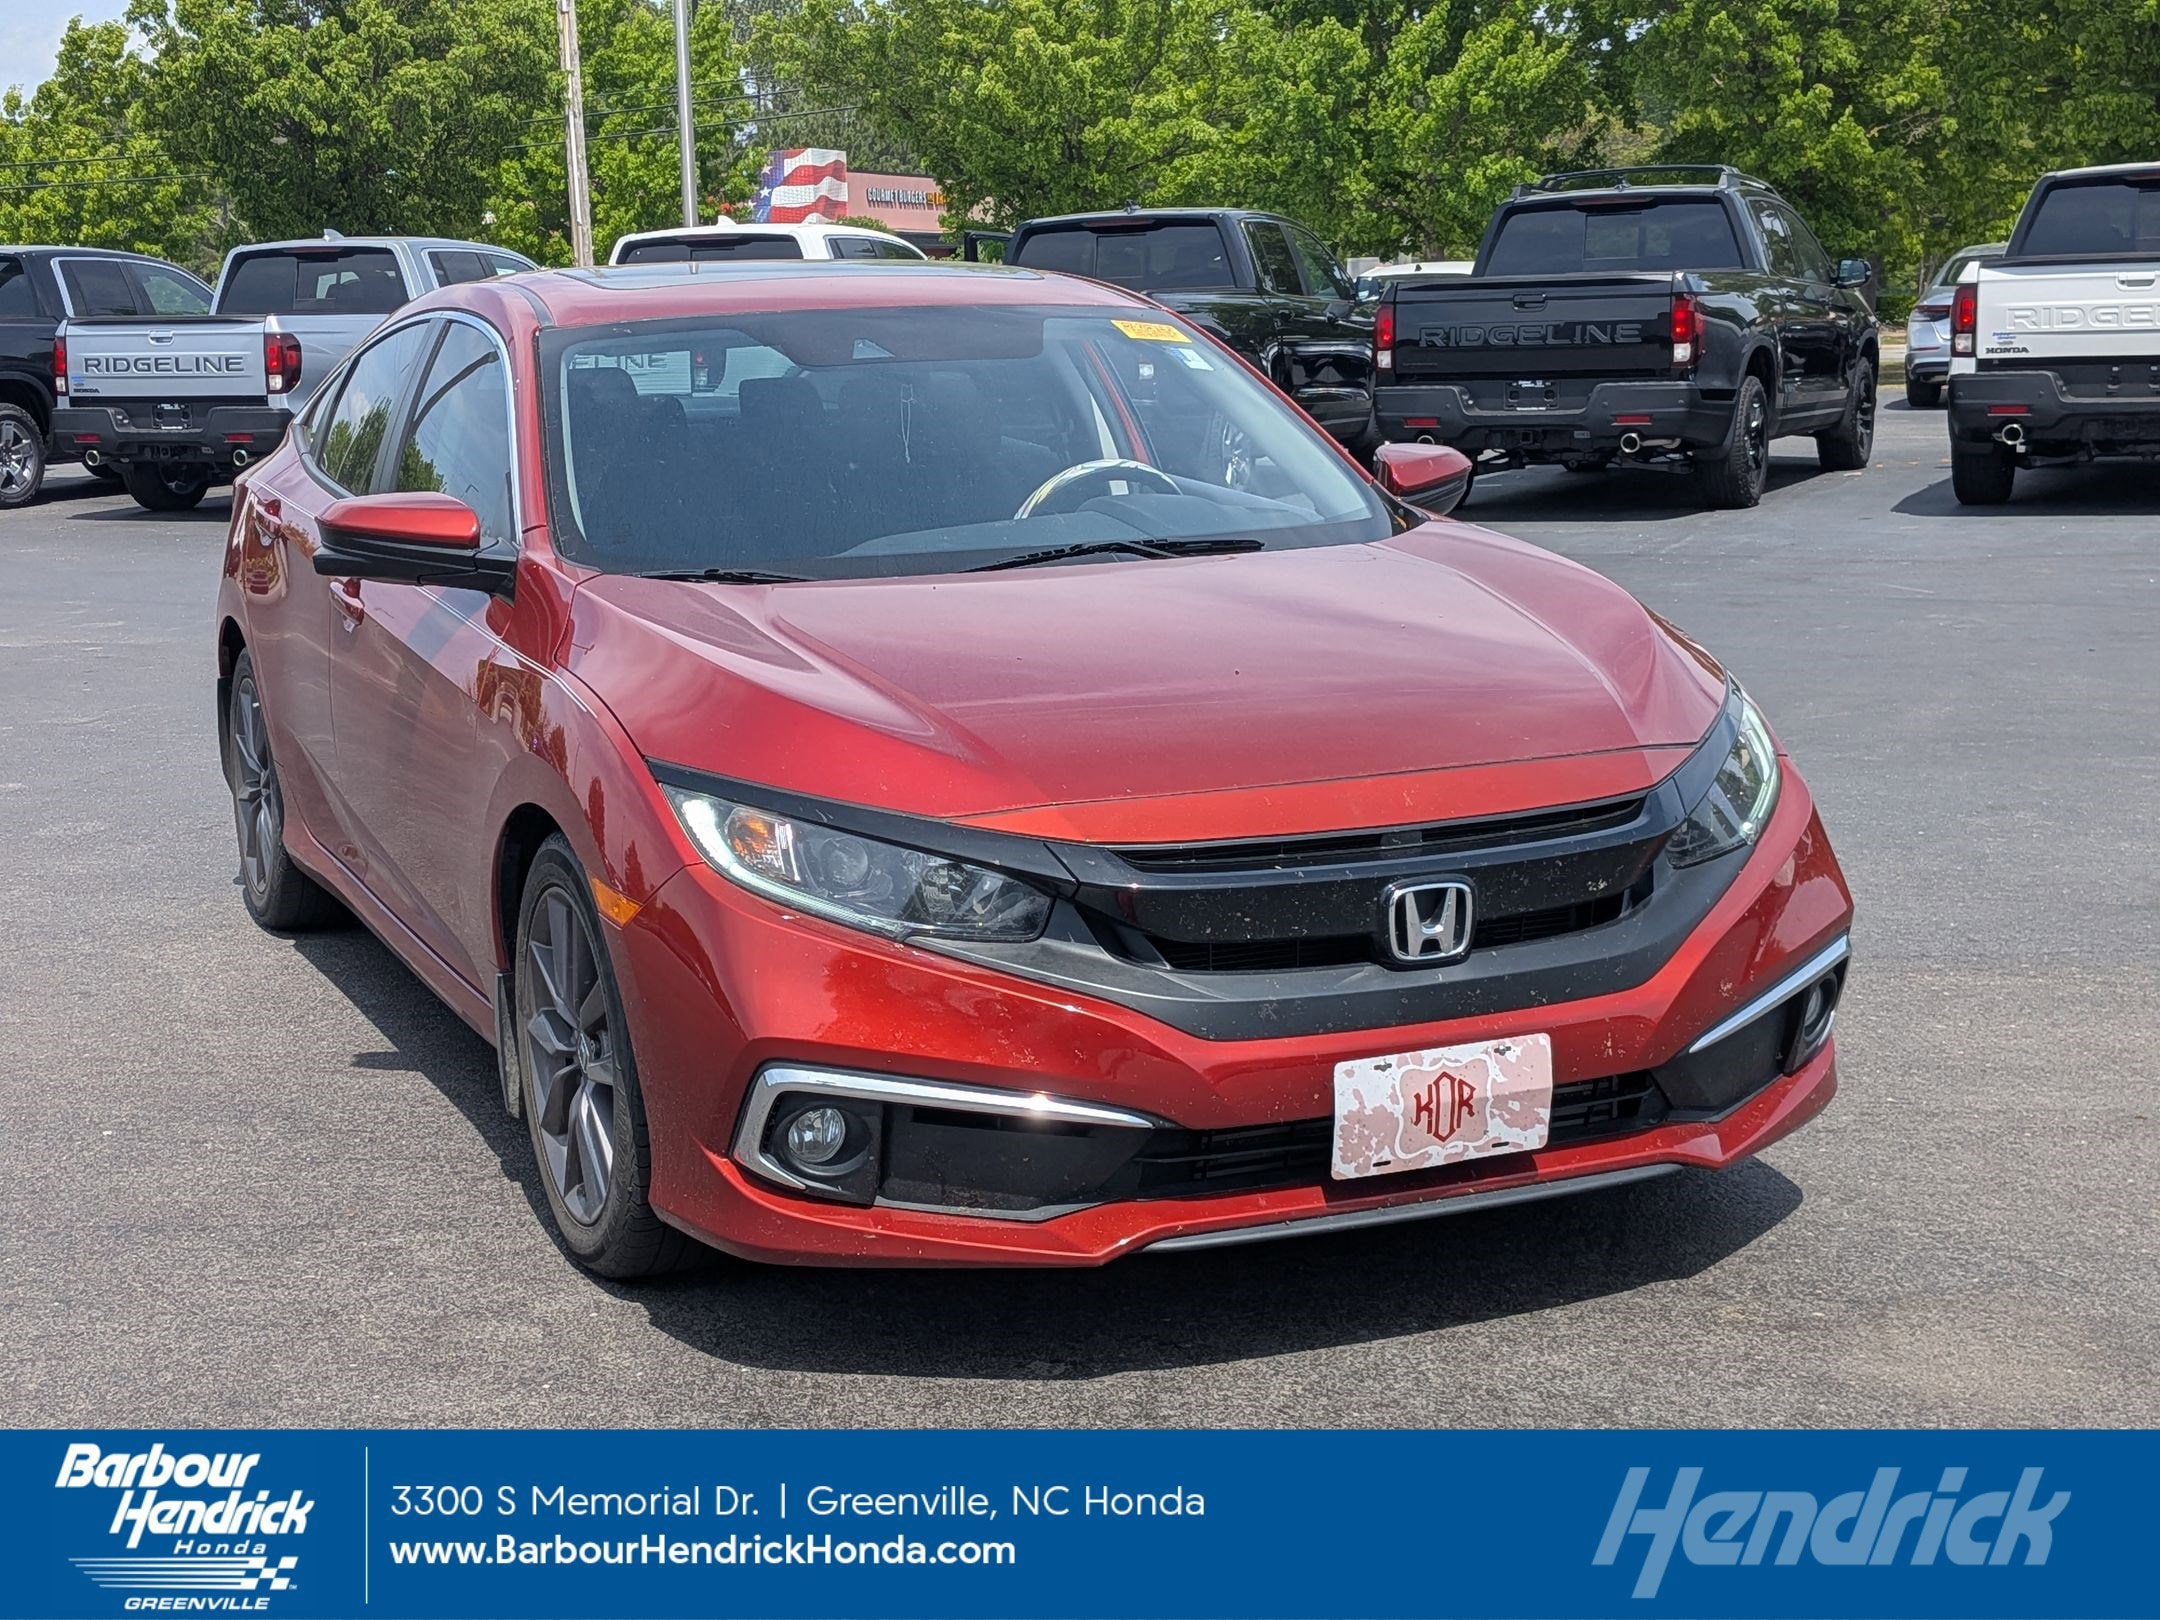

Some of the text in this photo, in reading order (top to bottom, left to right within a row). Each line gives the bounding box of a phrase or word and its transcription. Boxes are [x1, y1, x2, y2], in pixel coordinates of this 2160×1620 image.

[2006, 304, 2160, 330] RIDGE
[1419, 323, 1642, 348] RIDGELINE
[1985, 346, 2030, 355] HONDA
[83, 356, 246, 374] RIDGELINE
[571, 353, 668, 370] ELINE
